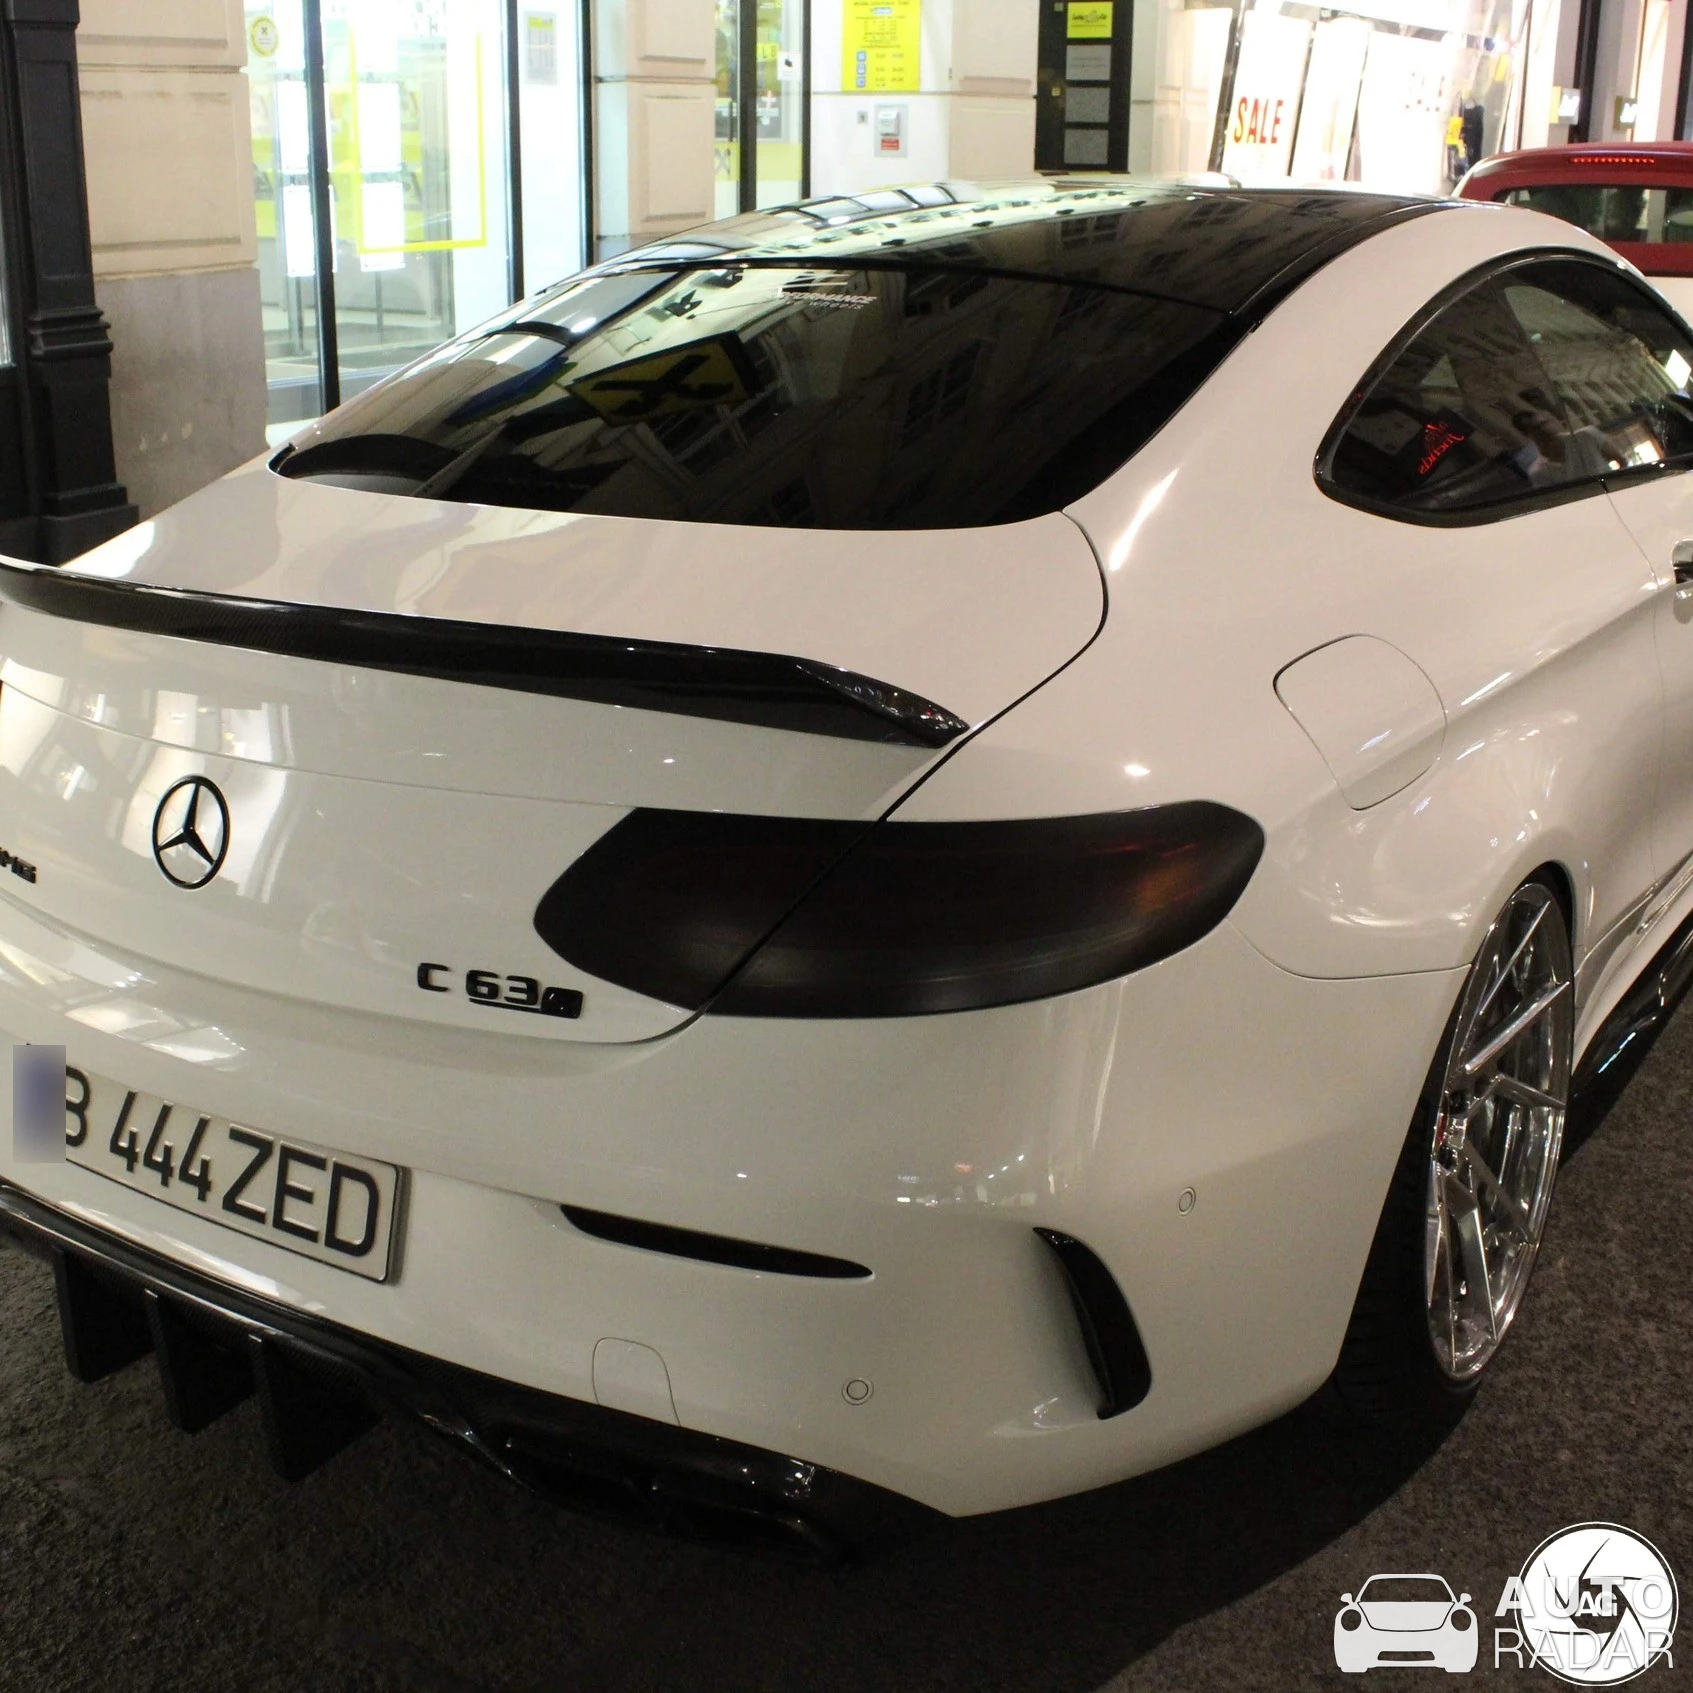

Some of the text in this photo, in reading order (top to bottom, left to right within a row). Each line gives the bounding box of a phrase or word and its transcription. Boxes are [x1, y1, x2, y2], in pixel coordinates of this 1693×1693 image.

[1234, 96, 1283, 144] SALE
[0, 847, 37, 884] MG
[417, 962, 450, 992] C
